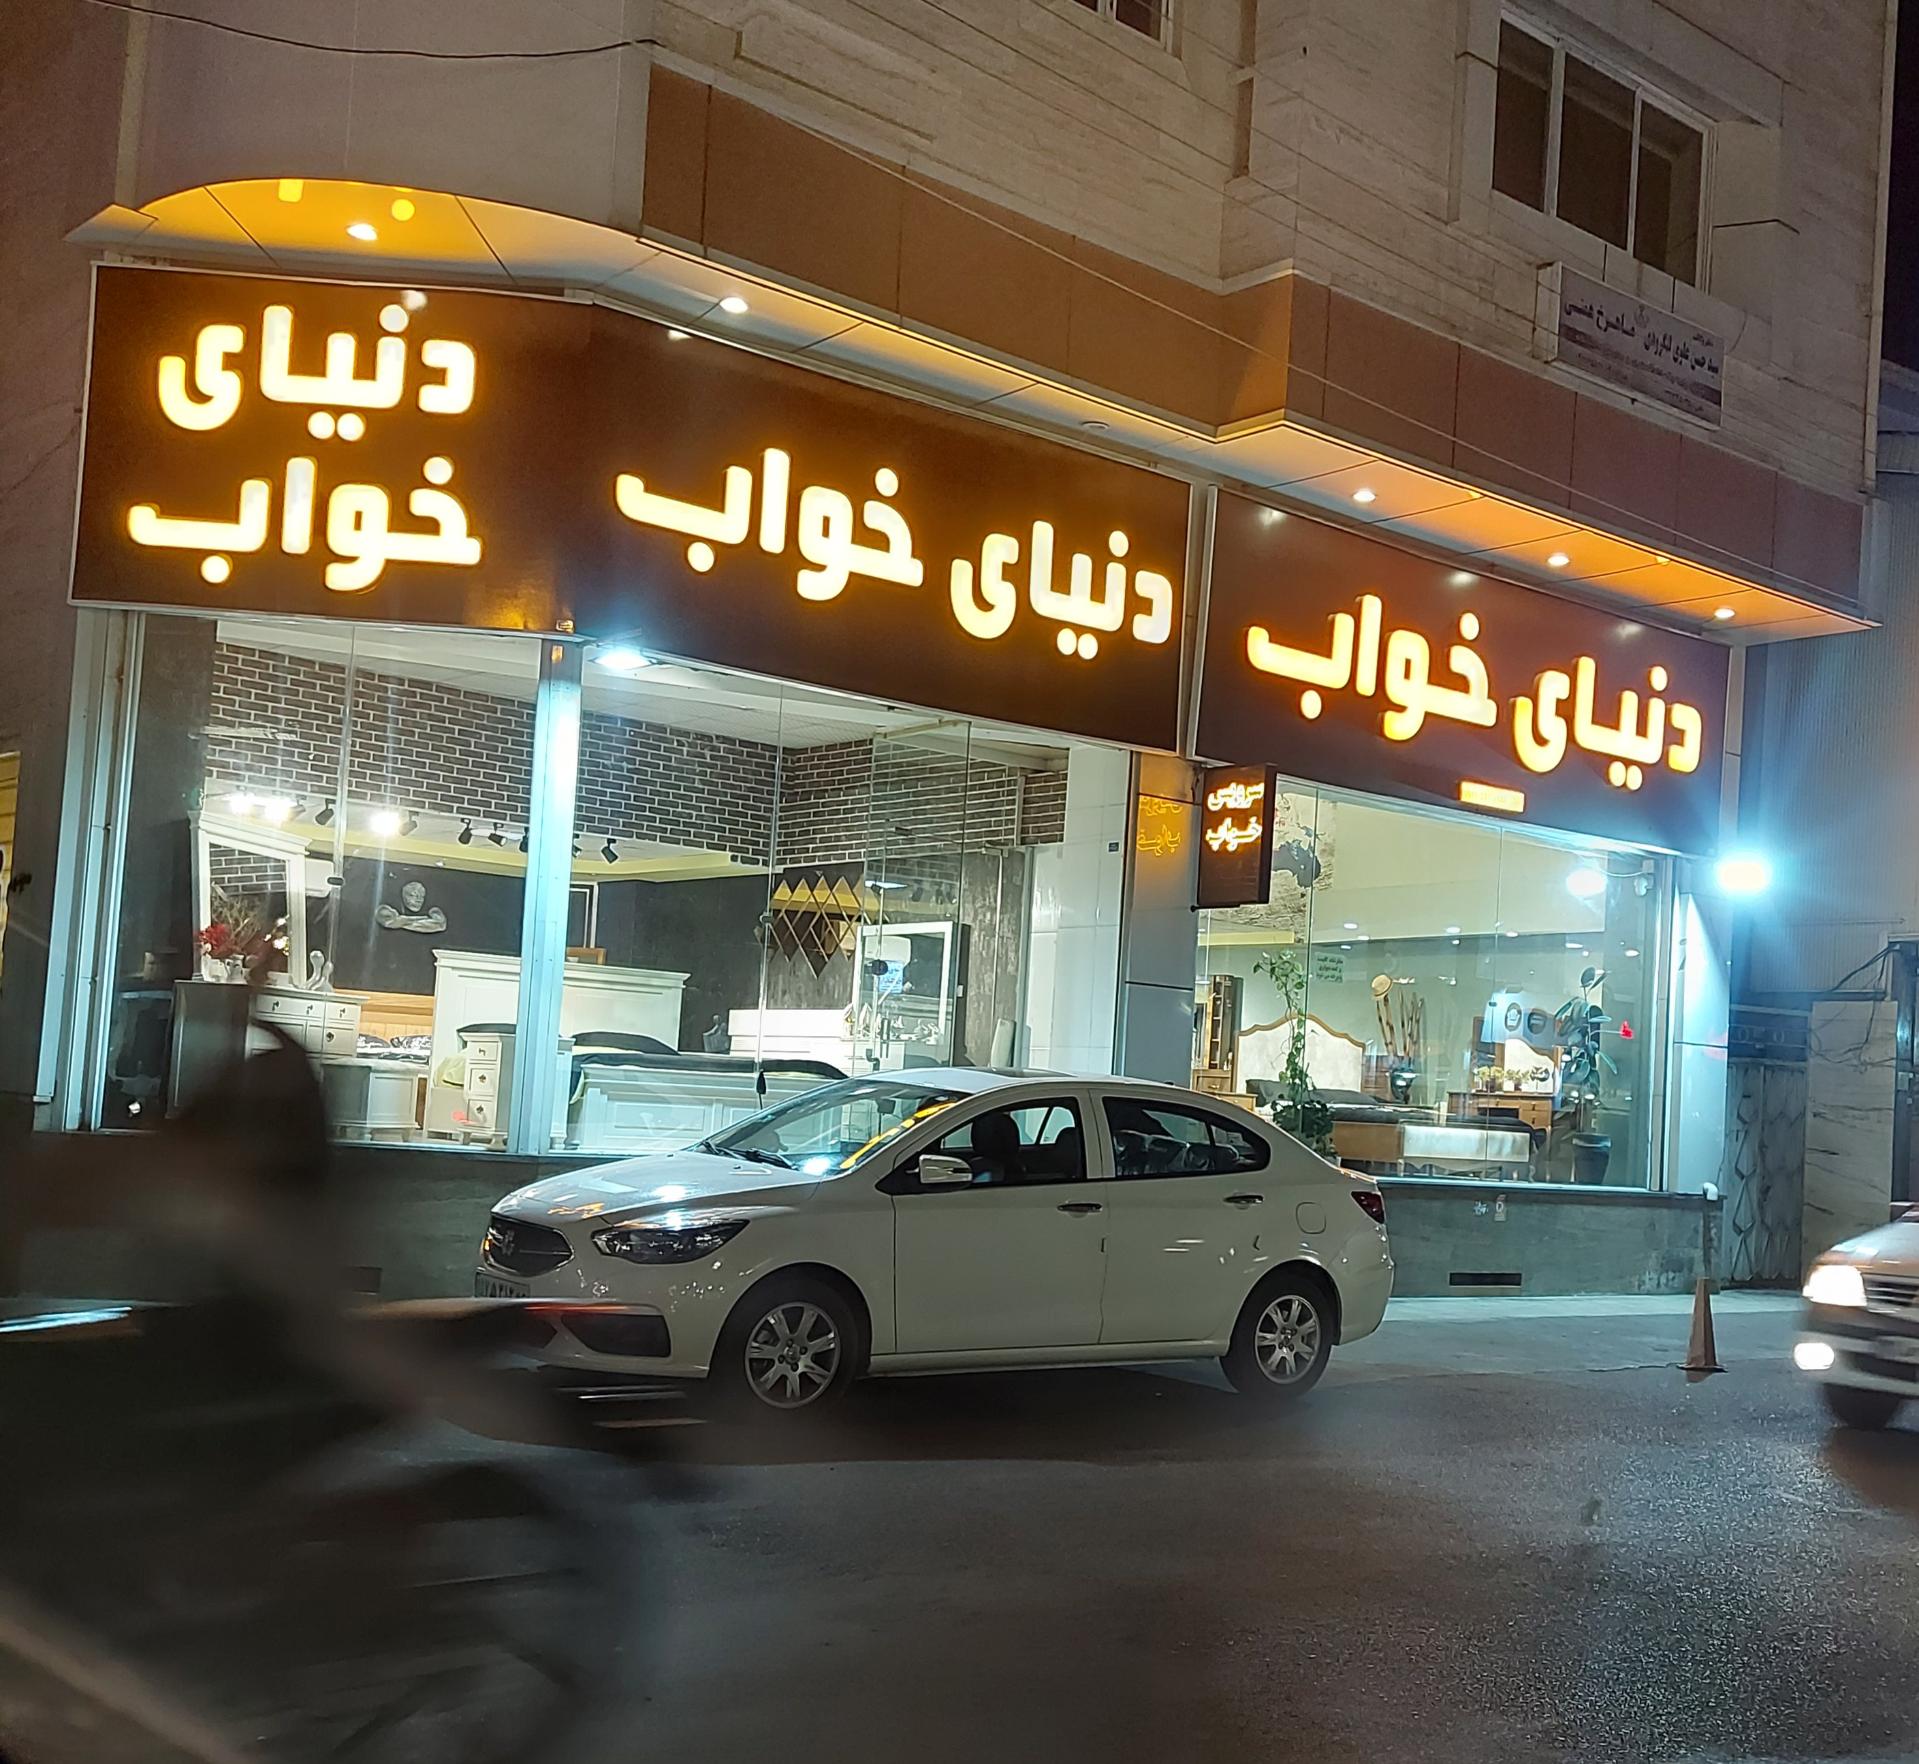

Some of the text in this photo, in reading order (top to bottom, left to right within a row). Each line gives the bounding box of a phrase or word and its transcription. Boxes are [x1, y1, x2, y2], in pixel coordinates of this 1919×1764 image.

[158, 303, 477, 442] دنیای
[127, 456, 482, 592] خواب
[615, 447, 1174, 660] دنیای خواب
[1246, 593, 1703, 792] دنیای خواب
[1205, 816, 1263, 852] خواب
[1207, 782, 1265, 811] سرویس
